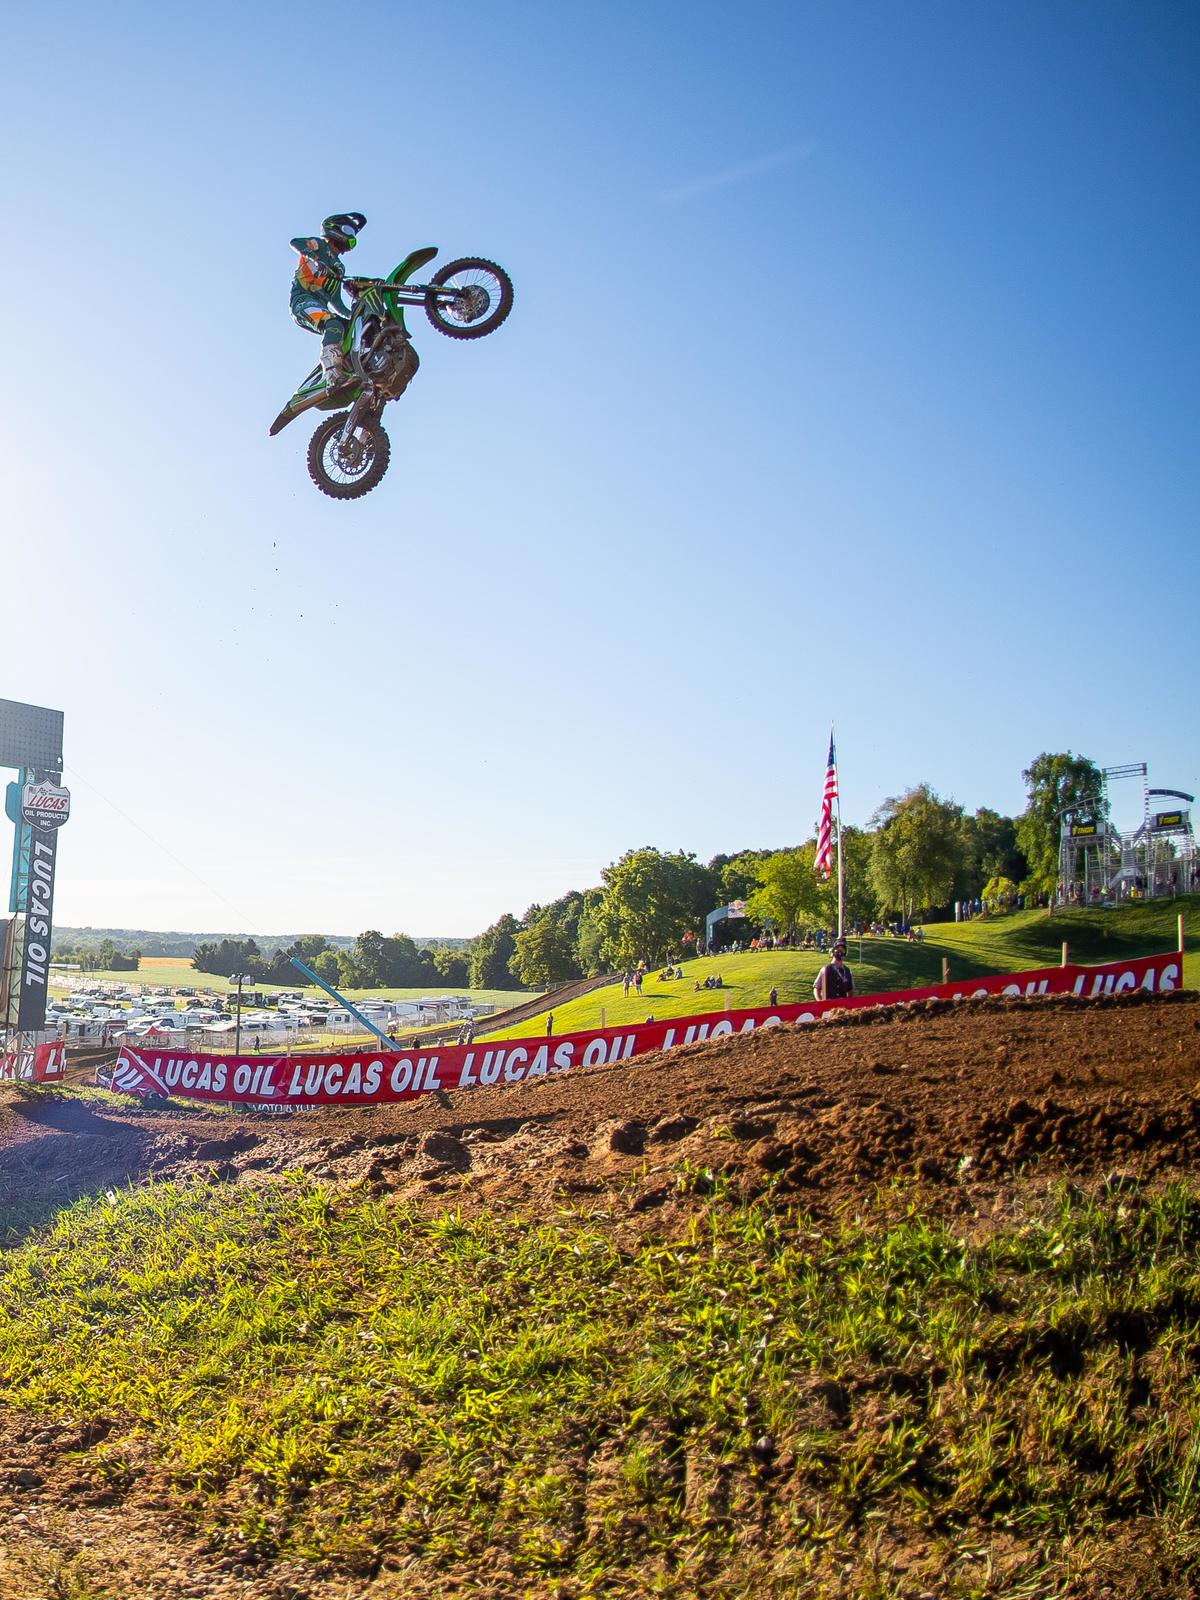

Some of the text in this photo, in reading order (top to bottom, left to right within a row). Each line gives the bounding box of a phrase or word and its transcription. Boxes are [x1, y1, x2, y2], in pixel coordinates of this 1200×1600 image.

[28, 795, 68, 810] LUCAS
[36, 811, 68, 820] PRODUCTS
[25, 841, 53, 986] LUCAS OIL
[153, 1058, 228, 1093] LUCAS
[233, 1064, 275, 1096] OIL
[288, 1060, 384, 1096] LUCAS
[390, 1056, 442, 1092] OIL
[458, 1042, 575, 1088] LUCAS
